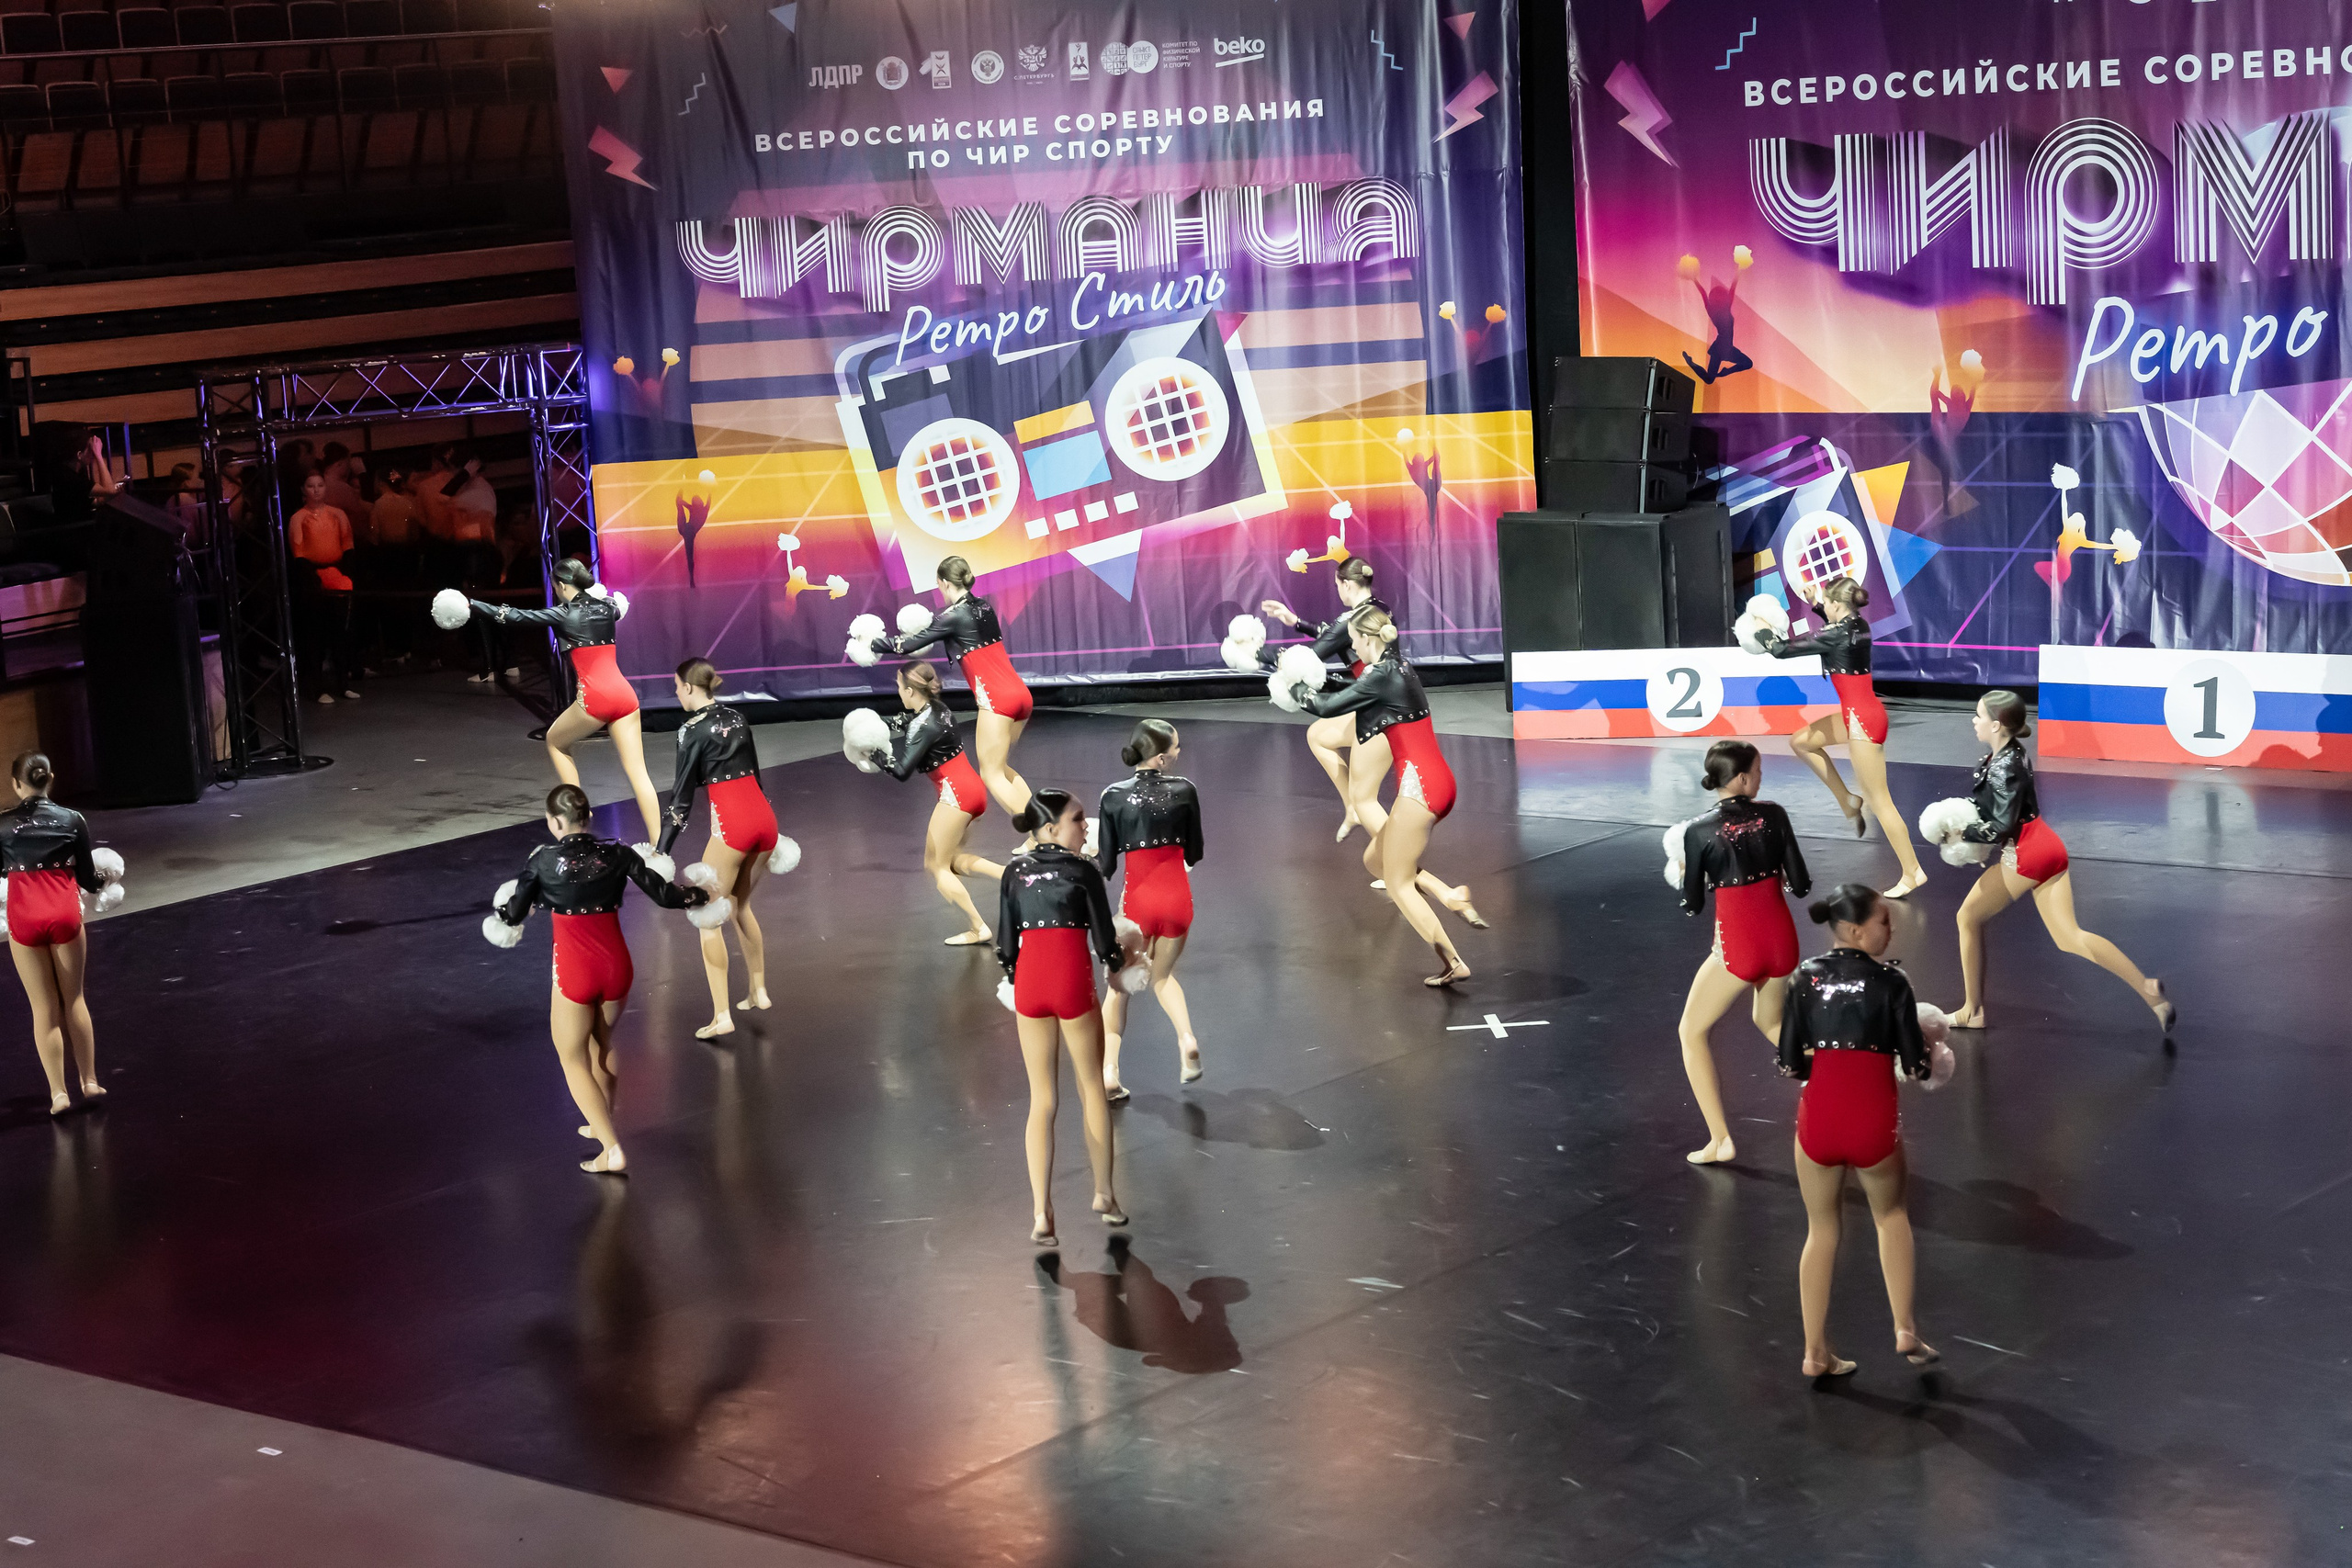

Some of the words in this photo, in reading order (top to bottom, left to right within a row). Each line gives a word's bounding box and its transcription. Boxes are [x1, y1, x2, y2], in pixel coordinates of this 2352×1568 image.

[1162, 47, 1201, 55] ФИЗИЧЕСКОЙ
[1214, 36, 1266, 55] beko
[808, 64, 863, 89] ЛДПР
[1744, 58, 2121, 107] ВСЕРОССИЙСКИЕ
[755, 118, 1038, 152] ВСЕРОССИЙСКИЕ
[1054, 98, 1325, 134] СОРЕВНОВАНИЯ
[908, 149, 950, 169] ПО
[966, 144, 1030, 165] ЧИР
[1046, 135, 1173, 161] СПОРТУ
[1748, 117, 2352, 306] ЧИРМ
[895, 305, 1049, 366] Ретро
[1070, 270, 1227, 331] Стиль
[2071, 296, 2329, 402] Ретро
[1666, 667, 1702, 718] 2
[2193, 676, 2225, 739] 1
